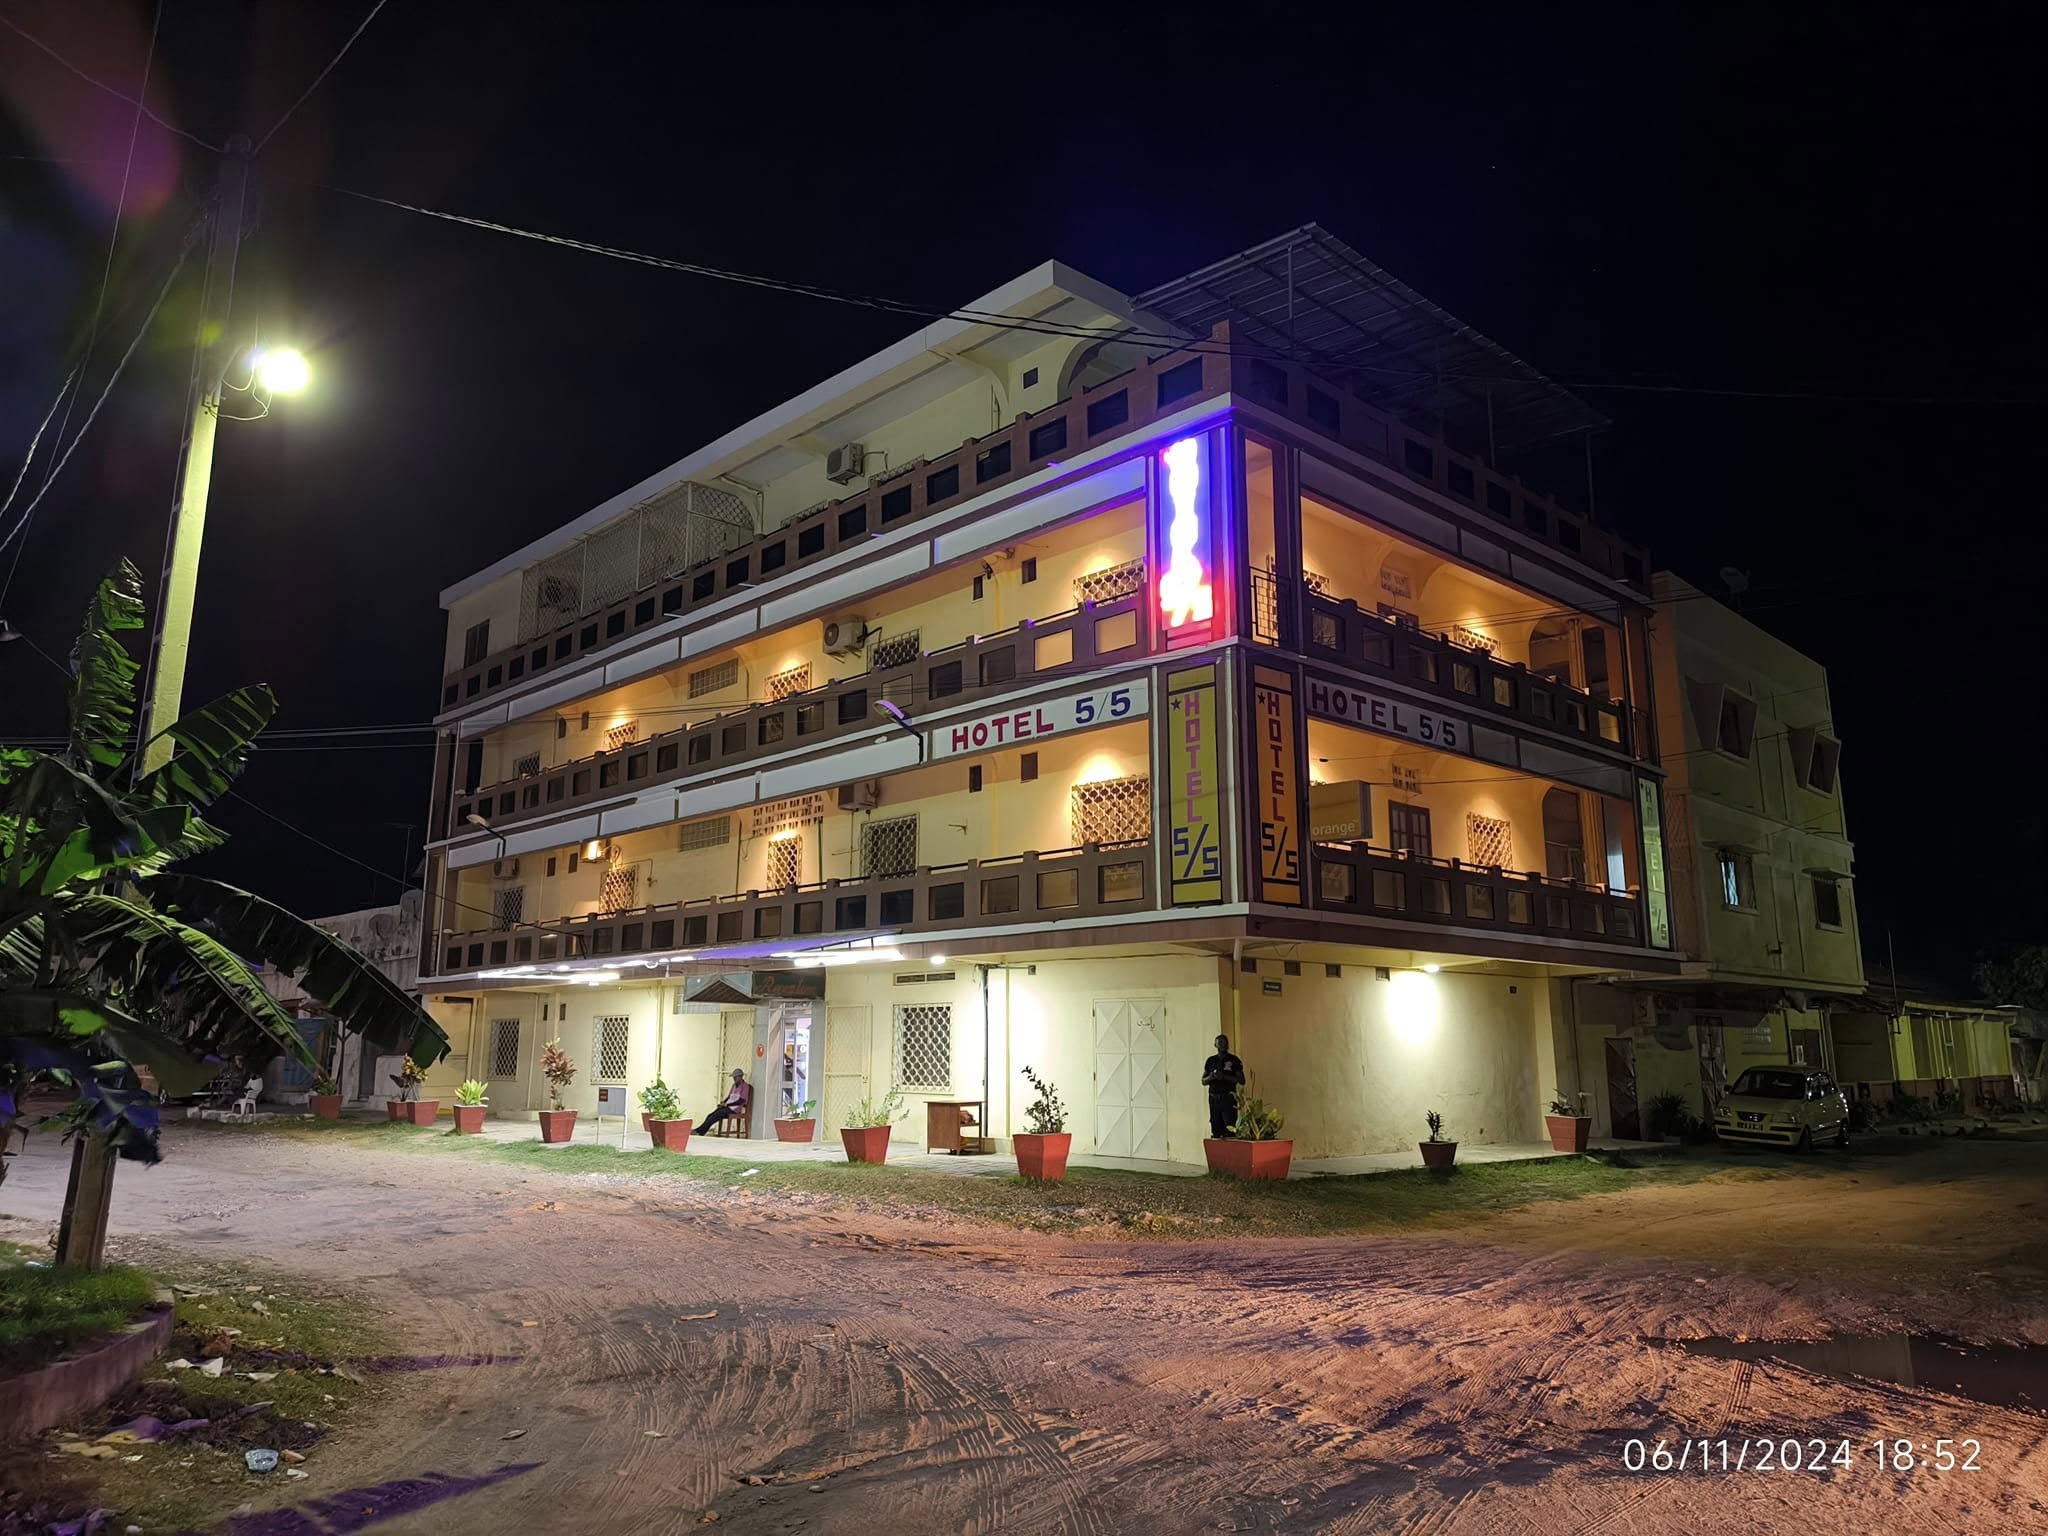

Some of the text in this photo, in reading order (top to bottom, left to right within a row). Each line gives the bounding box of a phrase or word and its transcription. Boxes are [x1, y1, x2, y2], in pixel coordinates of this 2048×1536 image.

[952, 688, 1131, 752] HOTEL 5/5
[1311, 682, 1456, 747] HOTEL 5/5
[1173, 692, 1220, 878] HOTEL 5/5
[1261, 691, 1298, 878] HOTEL 5/5
[1312, 822, 1355, 836] orange
